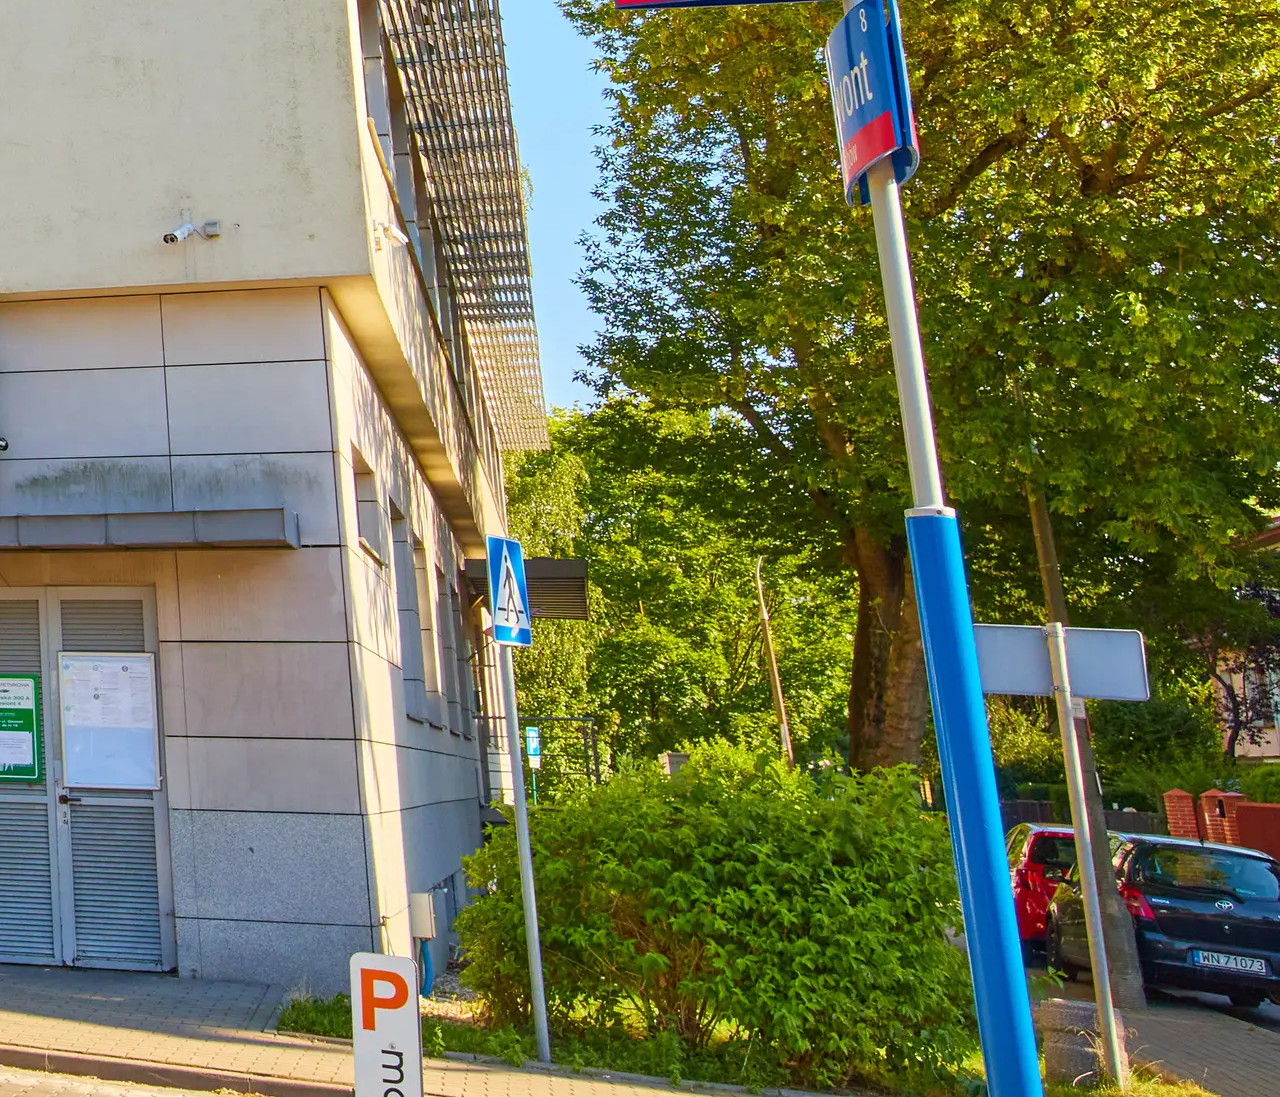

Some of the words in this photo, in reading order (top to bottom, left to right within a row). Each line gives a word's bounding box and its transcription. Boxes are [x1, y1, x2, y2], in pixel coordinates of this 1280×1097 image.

[1201, 952, 1220, 966] WN
[1223, 955, 1265, 971] 71073
[360, 967, 409, 1031] P
